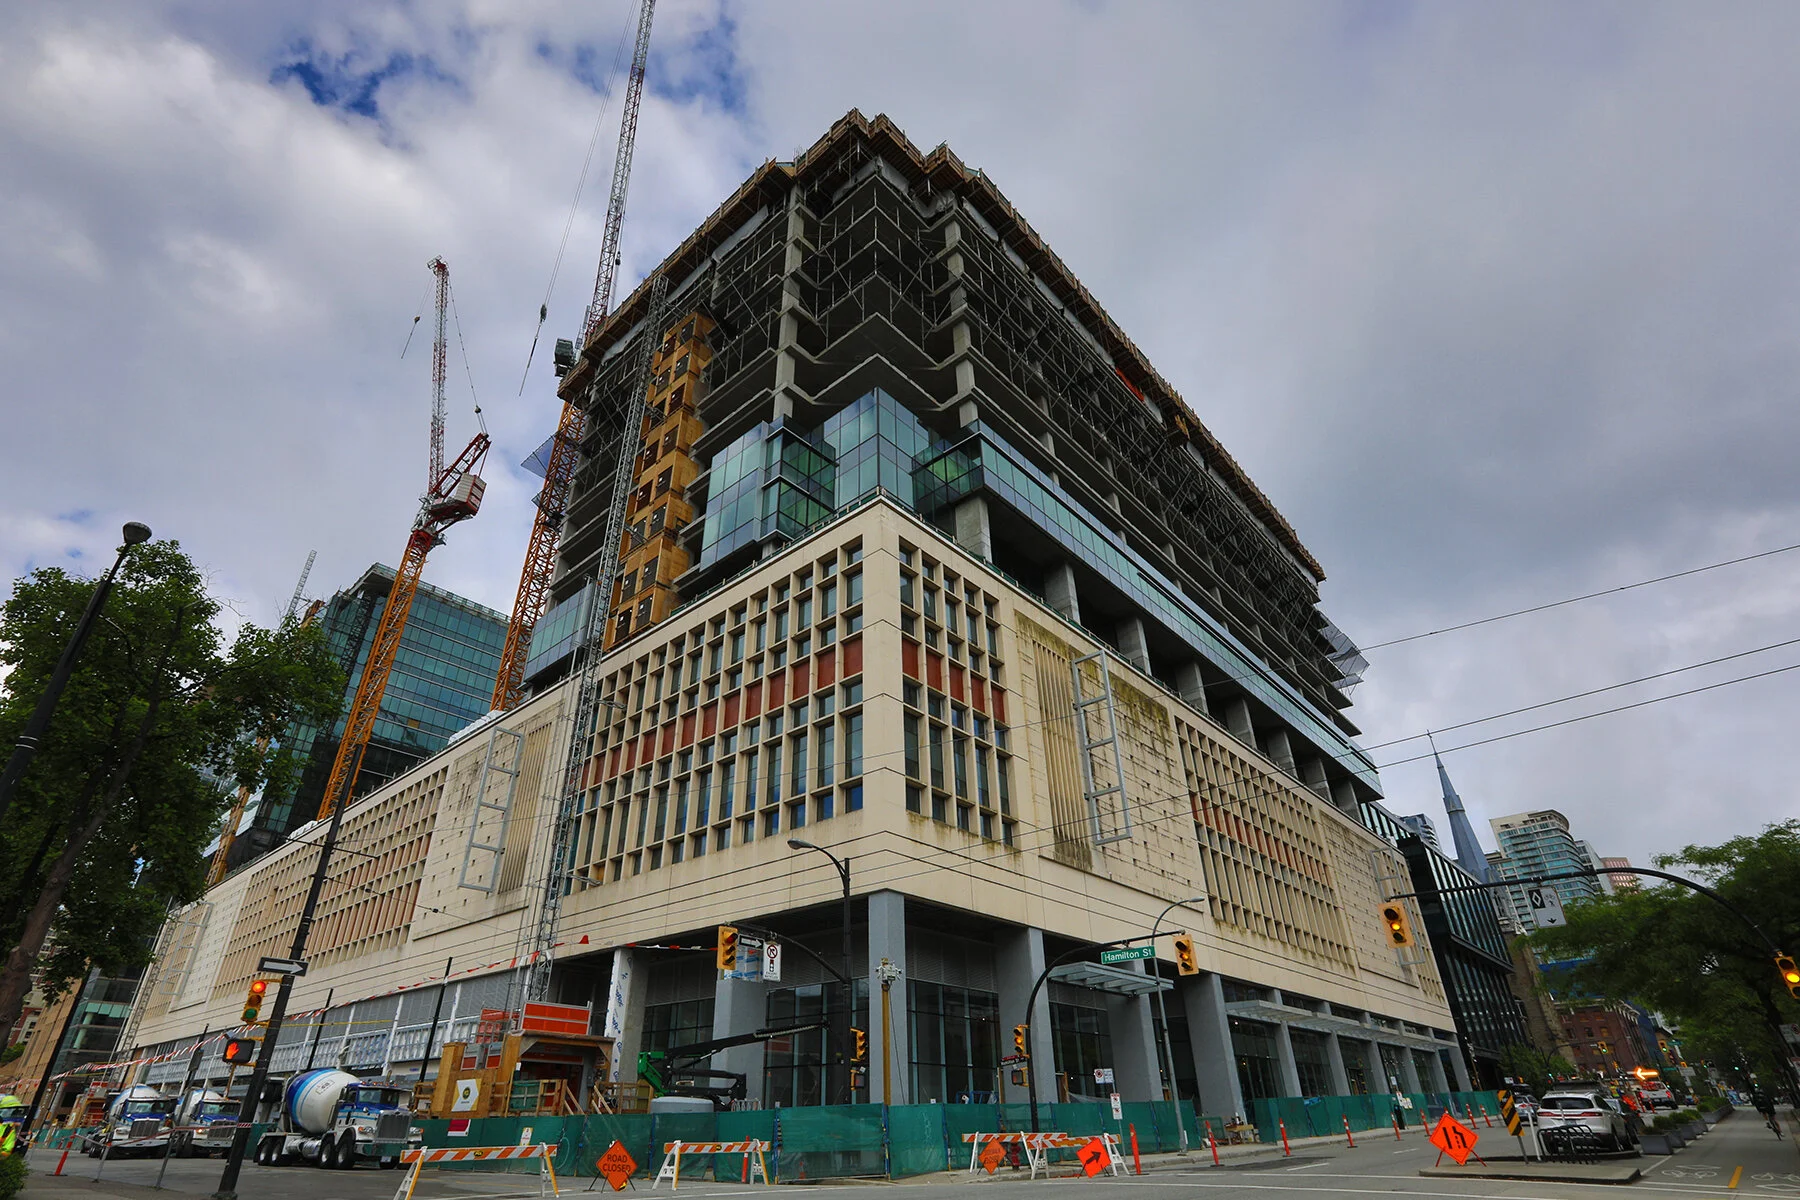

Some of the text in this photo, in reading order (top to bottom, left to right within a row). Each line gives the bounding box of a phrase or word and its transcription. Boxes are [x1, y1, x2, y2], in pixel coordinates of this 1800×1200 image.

[1104, 948, 1152, 961] Hamilton St
[607, 1154, 628, 1163] ROAD
[602, 1163, 631, 1172] CLOSED
